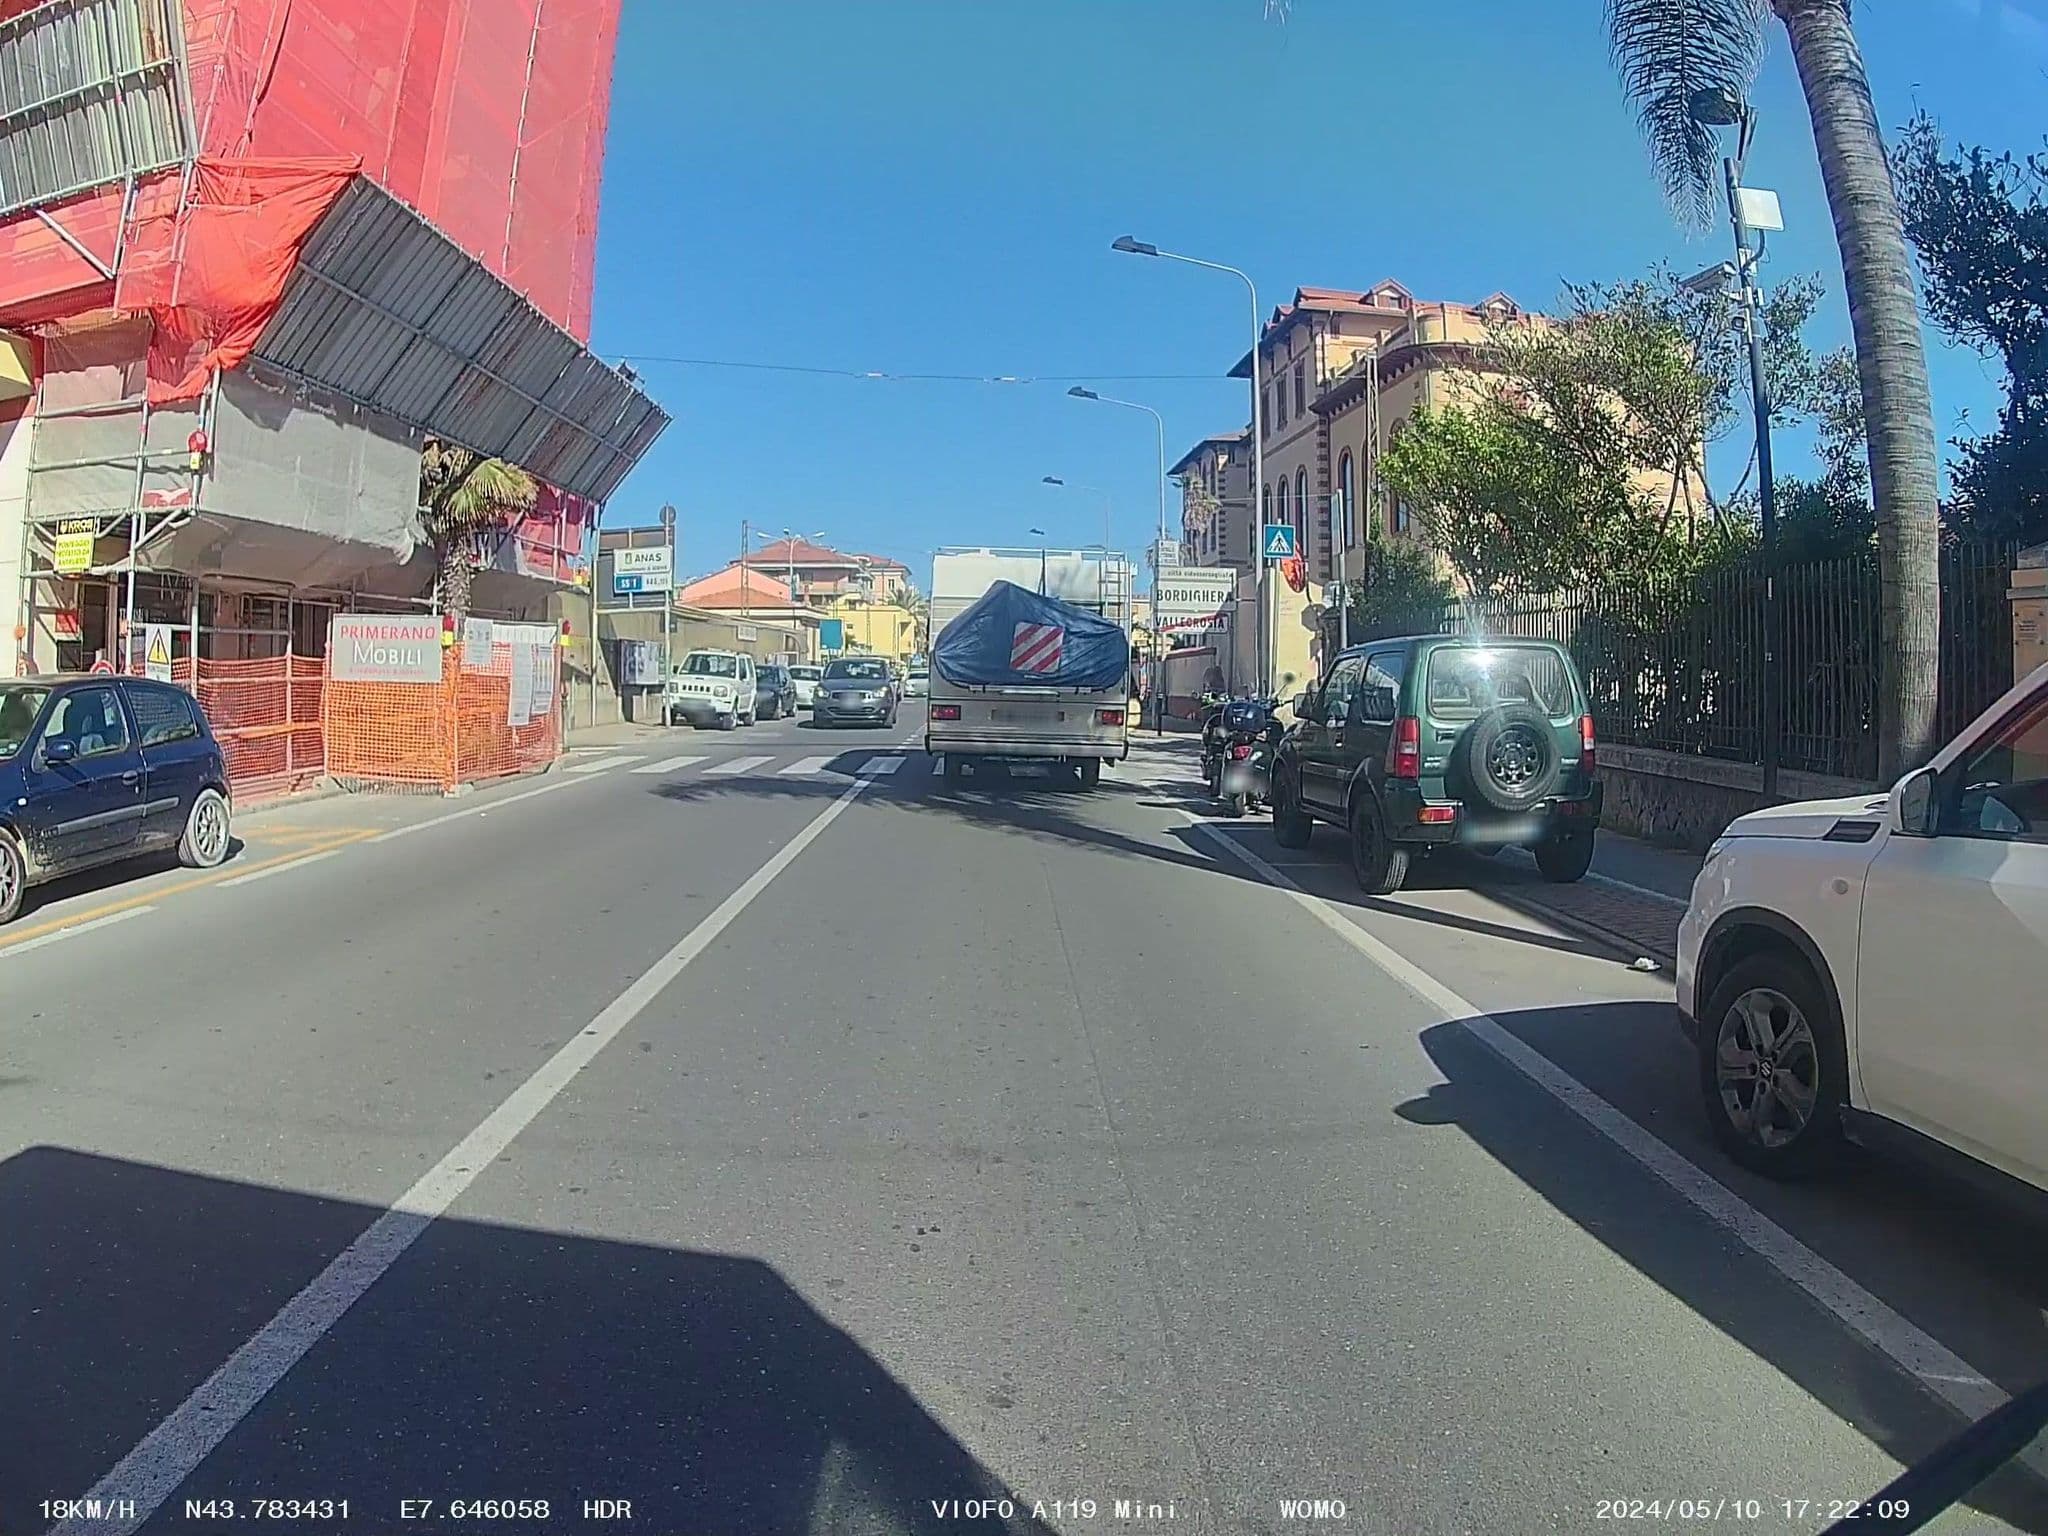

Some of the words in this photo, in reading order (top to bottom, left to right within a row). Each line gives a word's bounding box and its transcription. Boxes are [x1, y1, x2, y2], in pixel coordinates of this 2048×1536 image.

[635, 552, 662, 562] ANAS
[1157, 589, 1234, 603] BORDIGHERA
[340, 625, 435, 639] PRIMERANO
